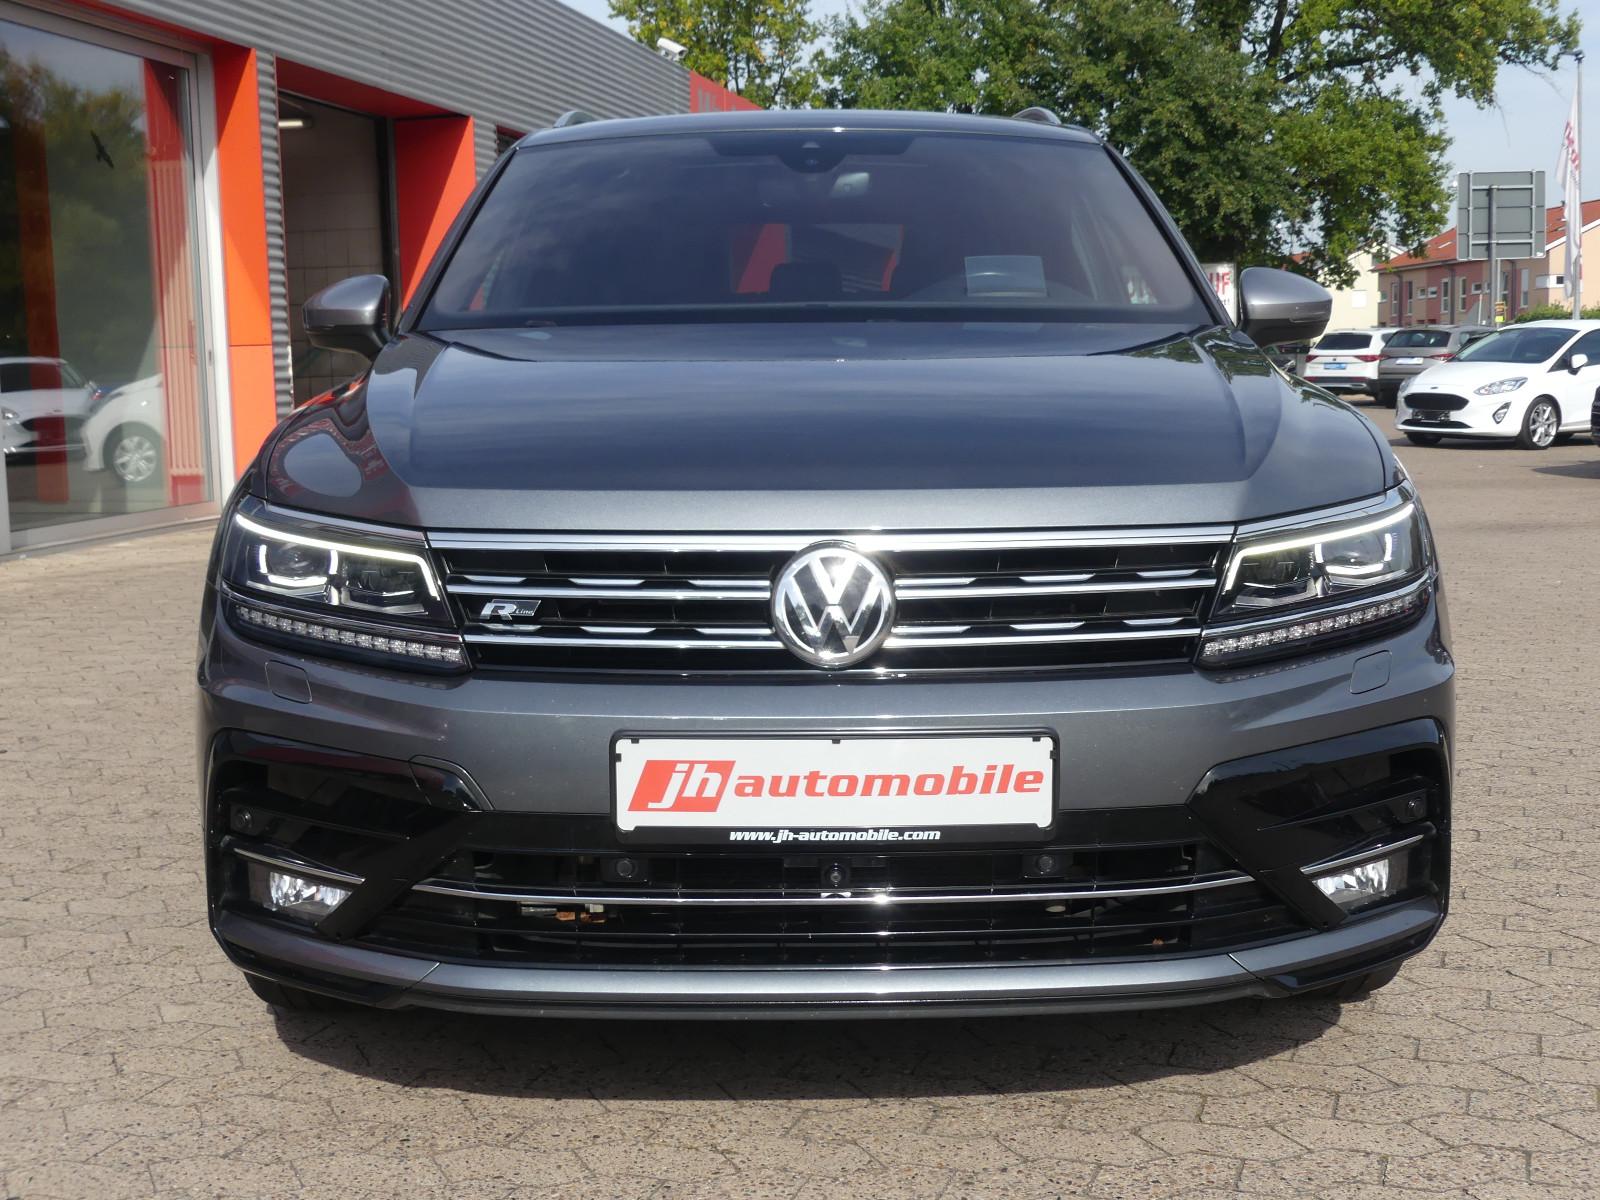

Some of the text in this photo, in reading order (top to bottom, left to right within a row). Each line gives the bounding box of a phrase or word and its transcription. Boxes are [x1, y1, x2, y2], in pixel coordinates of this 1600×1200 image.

[480, 602, 517, 620] R
[647, 763, 1045, 809] jh automobile
[729, 828, 941, 844] www.jh-automobile.com
